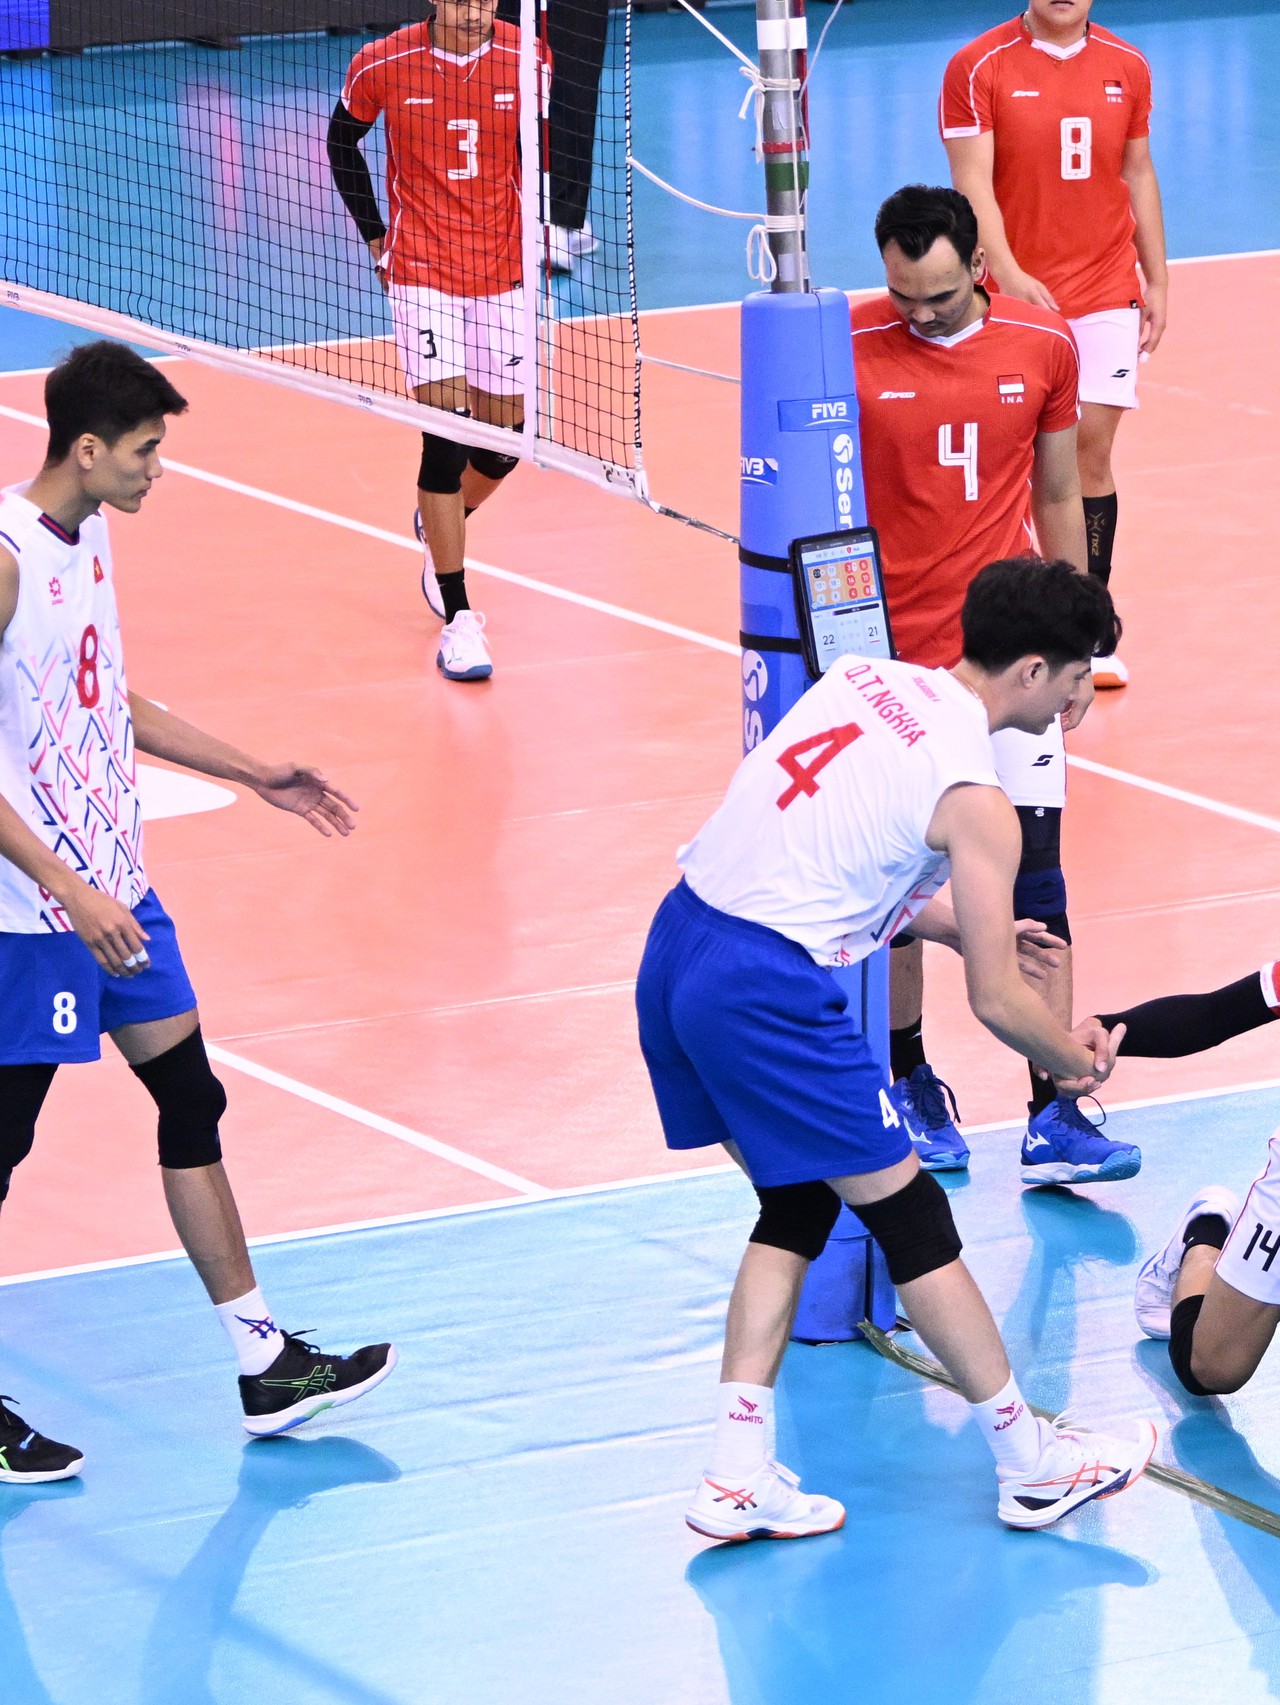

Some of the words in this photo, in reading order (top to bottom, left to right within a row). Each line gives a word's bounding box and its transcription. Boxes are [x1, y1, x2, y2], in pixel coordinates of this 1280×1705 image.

[446, 118, 478, 180] 3
[1060, 116, 1092, 180] 8
[419, 328, 437, 359] 3
[811, 401, 847, 419] FIVB
[1001, 395, 1024, 404] INA
[741, 456, 765, 476] IVB
[938, 422, 978, 501] 4
[822, 634, 836, 646] 22
[867, 626, 879, 637] 21
[76, 623, 101, 710] 8
[776, 722, 865, 812] 4
[52, 991, 78, 1034] 8
[878, 1088, 900, 1128] 4
[728, 1411, 764, 1425] KAMITO
